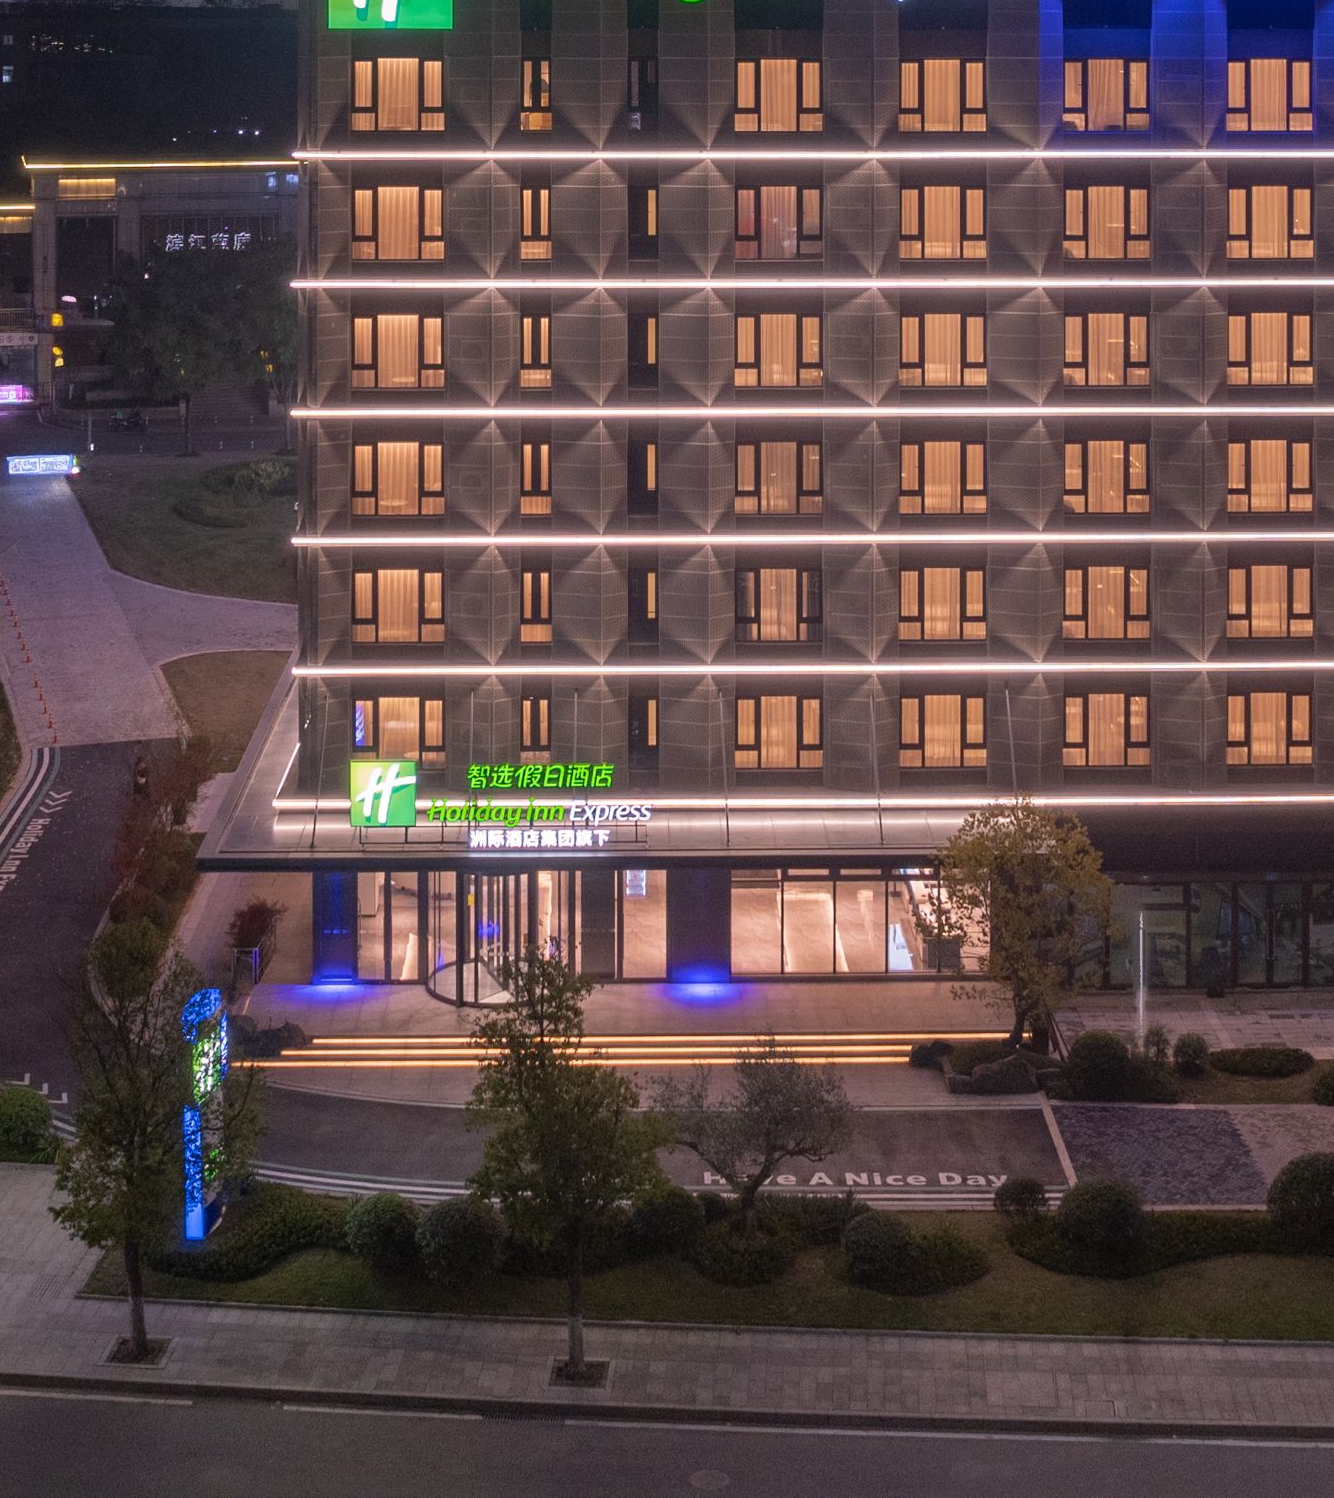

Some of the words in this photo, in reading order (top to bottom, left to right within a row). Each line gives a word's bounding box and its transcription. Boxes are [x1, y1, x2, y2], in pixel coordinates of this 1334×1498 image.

[466, 762, 615, 791] 智选假日酒店
[427, 798, 521, 826] Holiday
[569, 799, 653, 825] Express
[10, 818, 52, 854] Holiday
[469, 830, 611, 848] 洲际酒店集团旗下
[0, 854, 29, 873] Inn
[703, 1170, 797, 1186] He
[808, 1171, 835, 1186] A
[844, 1171, 928, 1186] Nice
[938, 1171, 1009, 1189] Day
